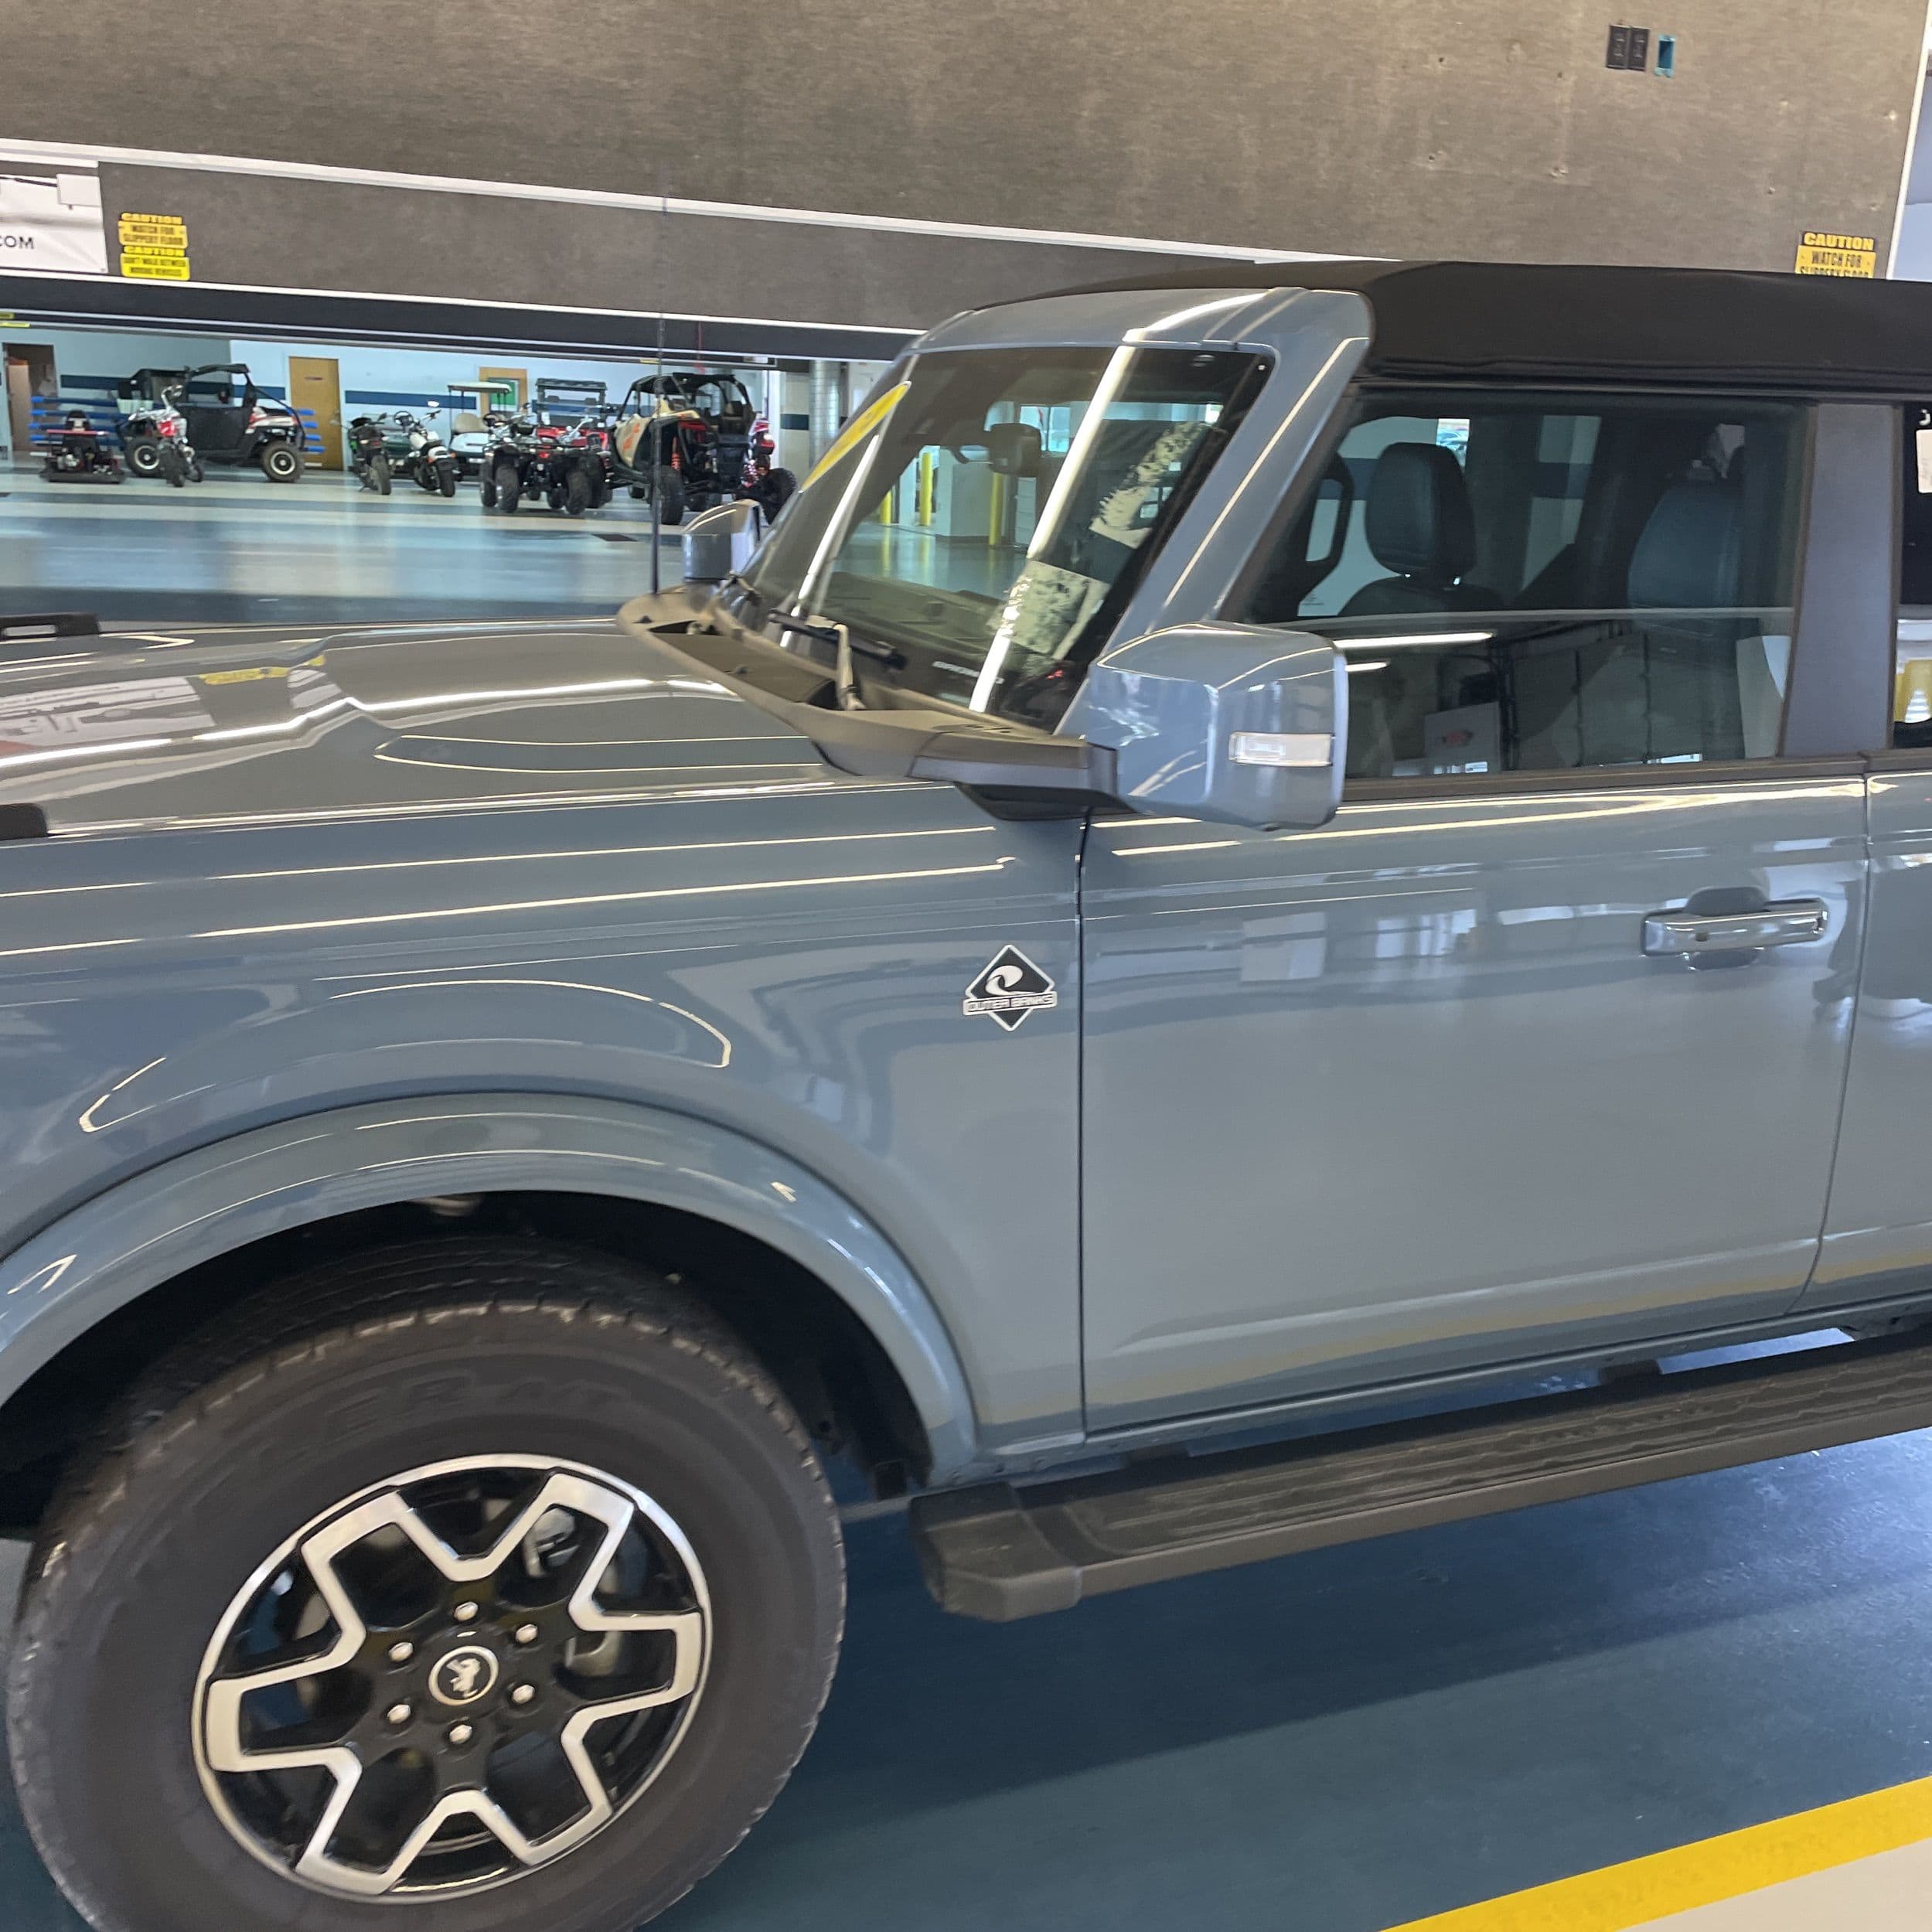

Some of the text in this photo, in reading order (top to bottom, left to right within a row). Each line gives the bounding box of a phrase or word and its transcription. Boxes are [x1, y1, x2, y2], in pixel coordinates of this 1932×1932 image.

[1804, 232, 1874, 250] CAUTION
[1811, 251, 1862, 268] WATCH FOR
